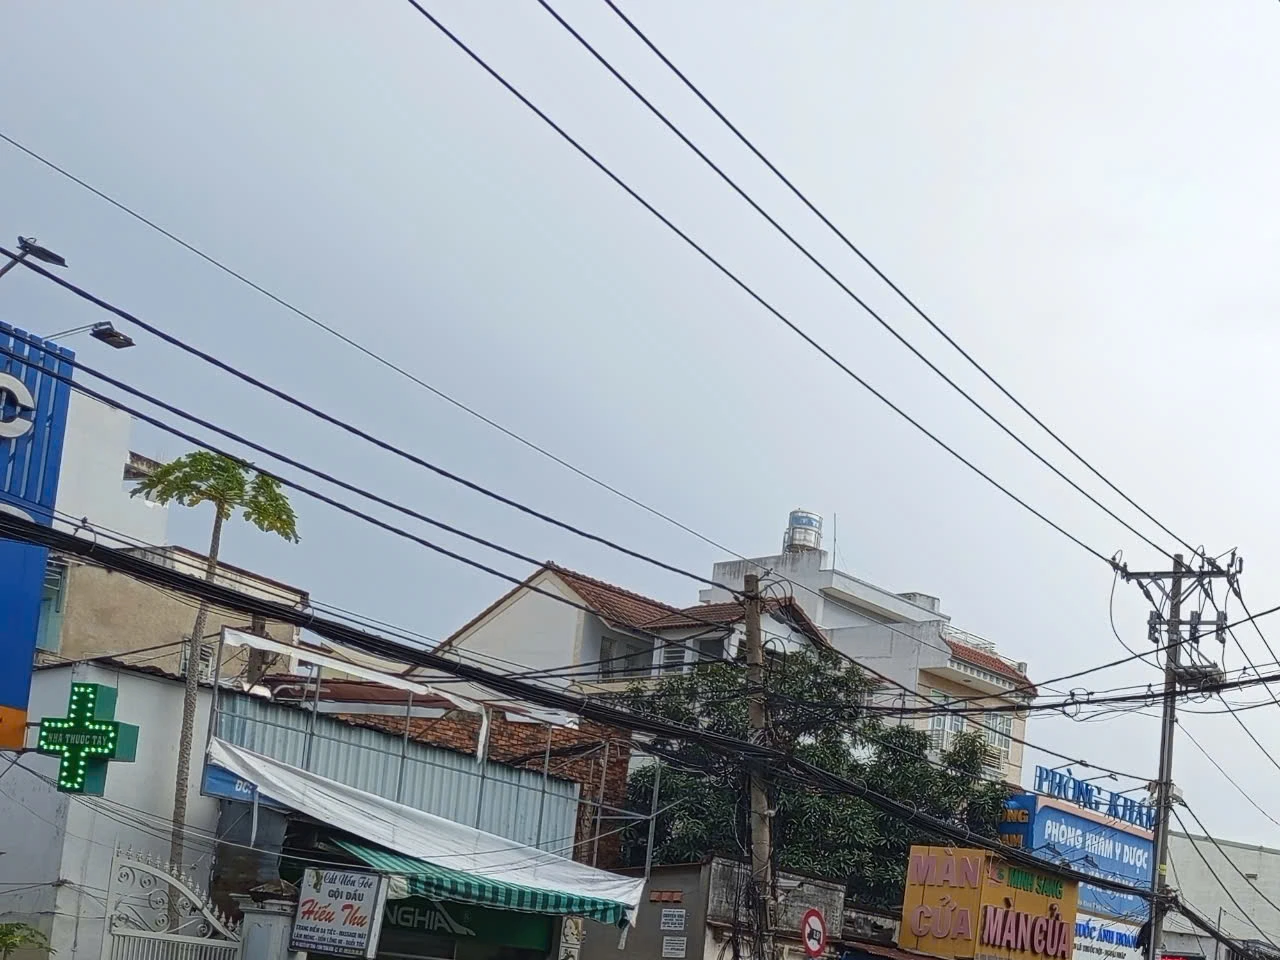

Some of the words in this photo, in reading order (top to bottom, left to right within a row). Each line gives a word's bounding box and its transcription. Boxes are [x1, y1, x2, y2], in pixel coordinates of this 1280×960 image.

[1034, 765, 1100, 810] PHÒNG
[910, 847, 982, 889] MÀN
[1045, 818, 1083, 849] PHÒNG
[1085, 831, 1113, 859] KHÁM
[1115, 844, 1122, 861] Y
[1123, 845, 1148, 875] DƯỢC
[328, 888, 342, 900] GỘI
[1007, 867, 1033, 893] MINH
[1034, 874, 1063, 900] SANG
[341, 903, 367, 928] Thu
[911, 895, 972, 941] CỬA
[980, 897, 1032, 953] MÀN
[1031, 903, 1072, 960] CỬA
